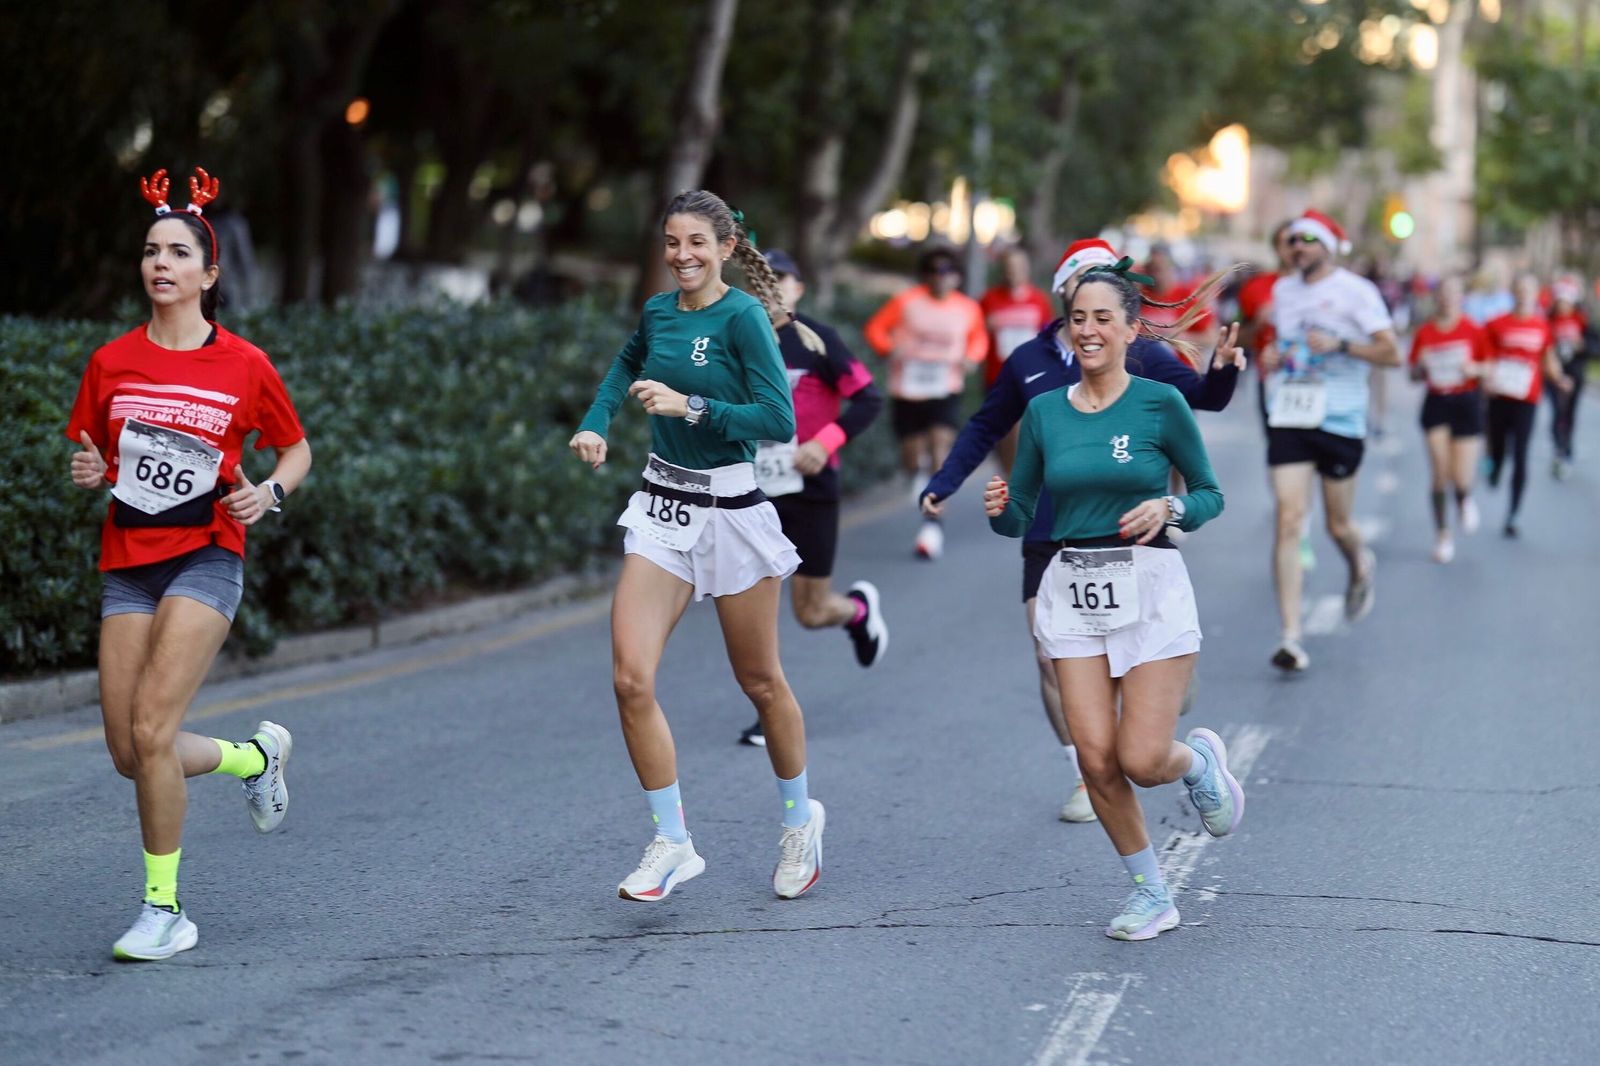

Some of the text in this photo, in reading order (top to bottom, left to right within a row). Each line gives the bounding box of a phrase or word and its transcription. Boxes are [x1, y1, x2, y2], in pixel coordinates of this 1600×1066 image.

[135, 409, 227, 437] PALMA PALMILLA
[162, 406, 231, 427] SAN SILVESTRE
[183, 401, 233, 422] CARRERA
[136, 455, 195, 496] 686
[682, 481, 710, 492] XIV
[646, 493, 691, 527] 186
[1069, 582, 1119, 609] 161
[271, 753, 283, 813] HYROX
